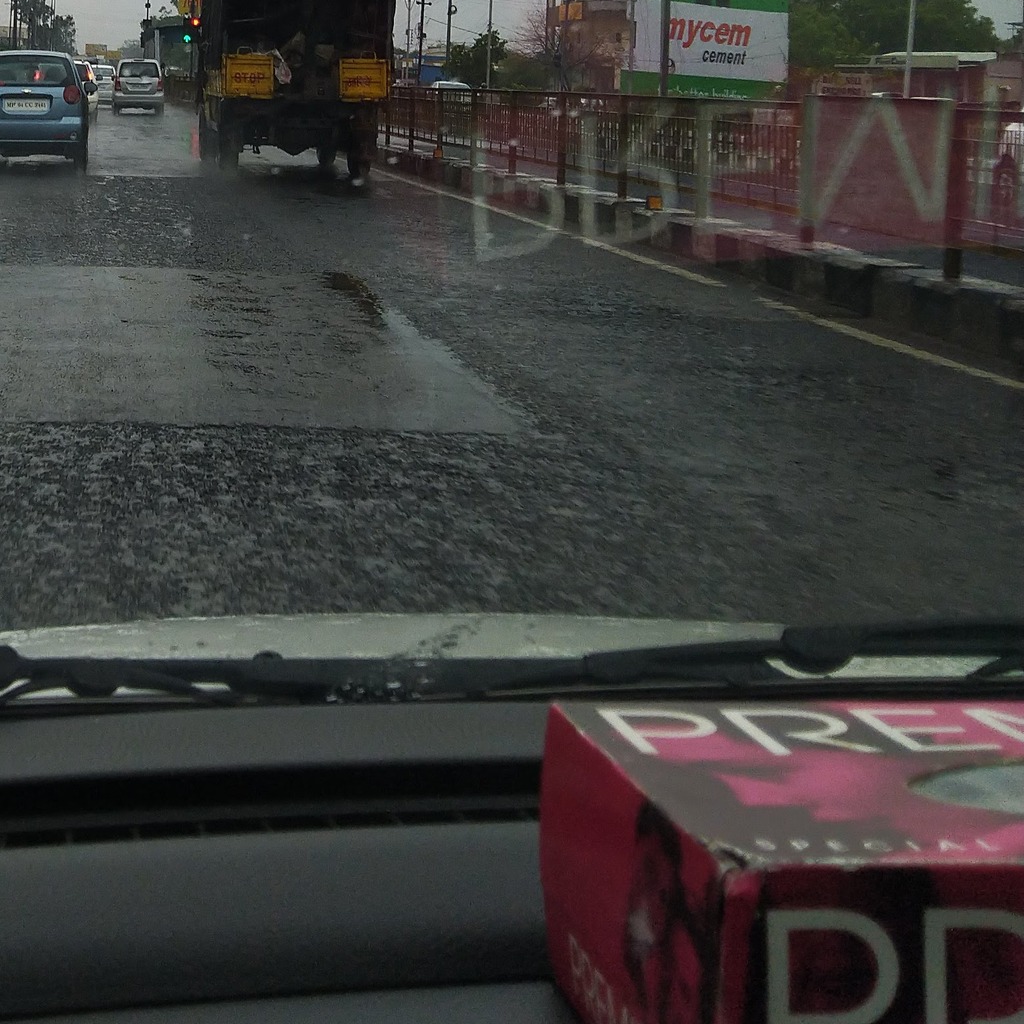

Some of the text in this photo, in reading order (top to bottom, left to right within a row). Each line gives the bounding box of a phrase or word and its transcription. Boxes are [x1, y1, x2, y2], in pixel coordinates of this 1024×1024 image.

[669, 17, 752, 48] mycem
[702, 49, 747, 65] cement
[233, 71, 265, 85] STOP
